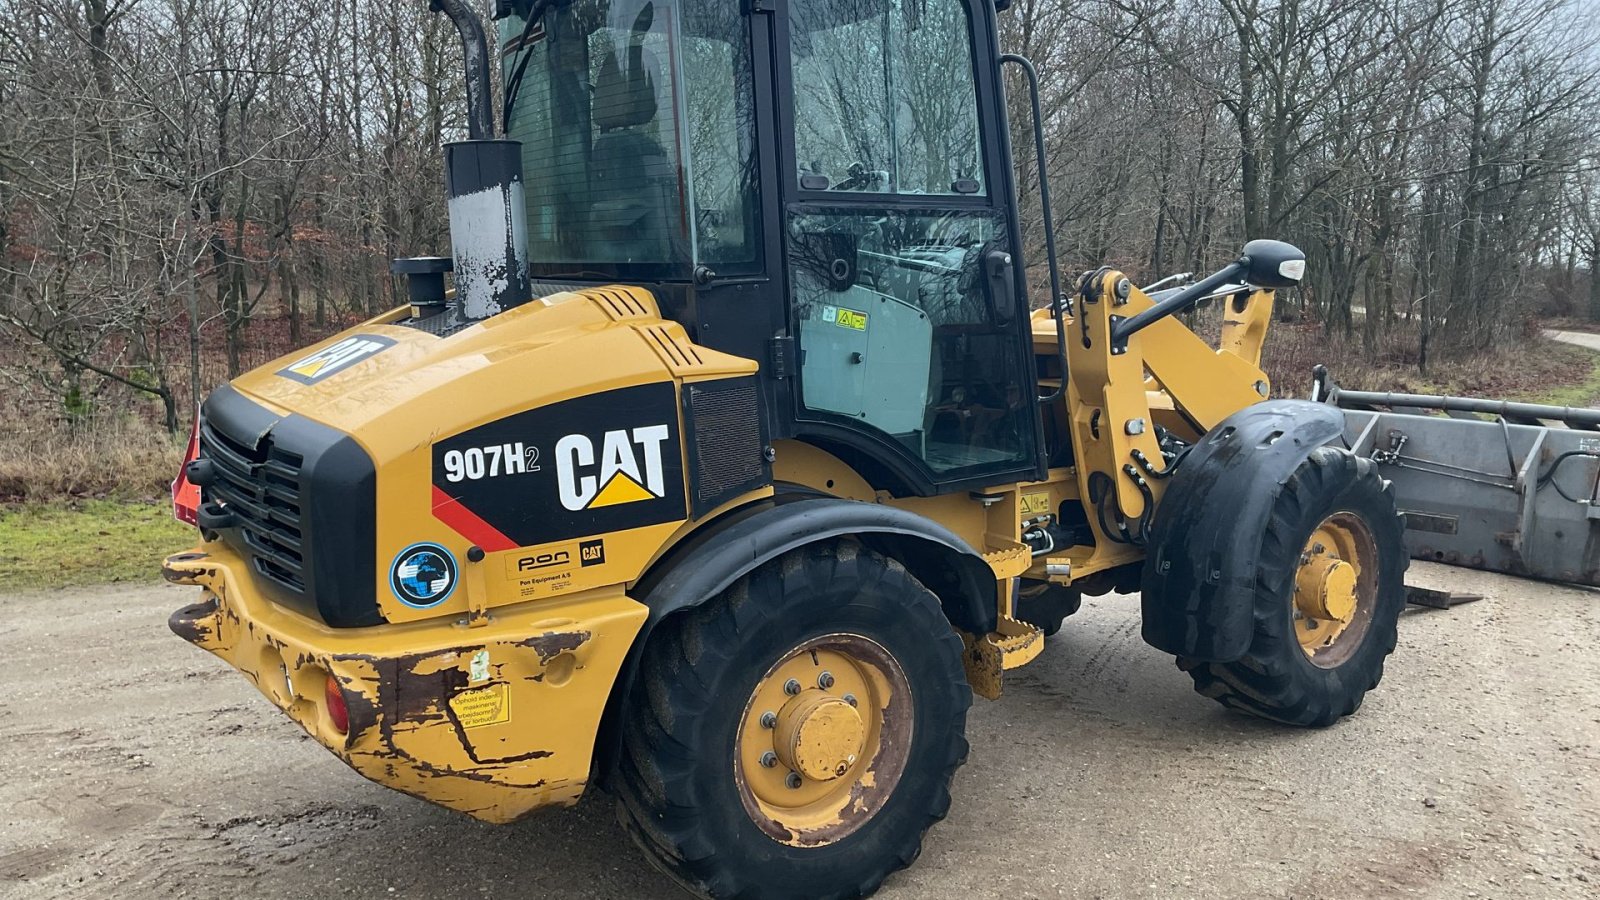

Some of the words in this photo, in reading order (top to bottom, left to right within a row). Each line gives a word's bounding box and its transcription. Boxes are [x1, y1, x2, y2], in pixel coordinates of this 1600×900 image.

[287, 338, 385, 379] CAT
[444, 442, 541, 483] 907H2
[555, 424, 669, 511] CAT
[582, 545, 602, 560] CAT
[531, 574, 561, 584] Equipment
[454, 697, 477, 705] Ophold
[472, 716, 495, 724] forbud
